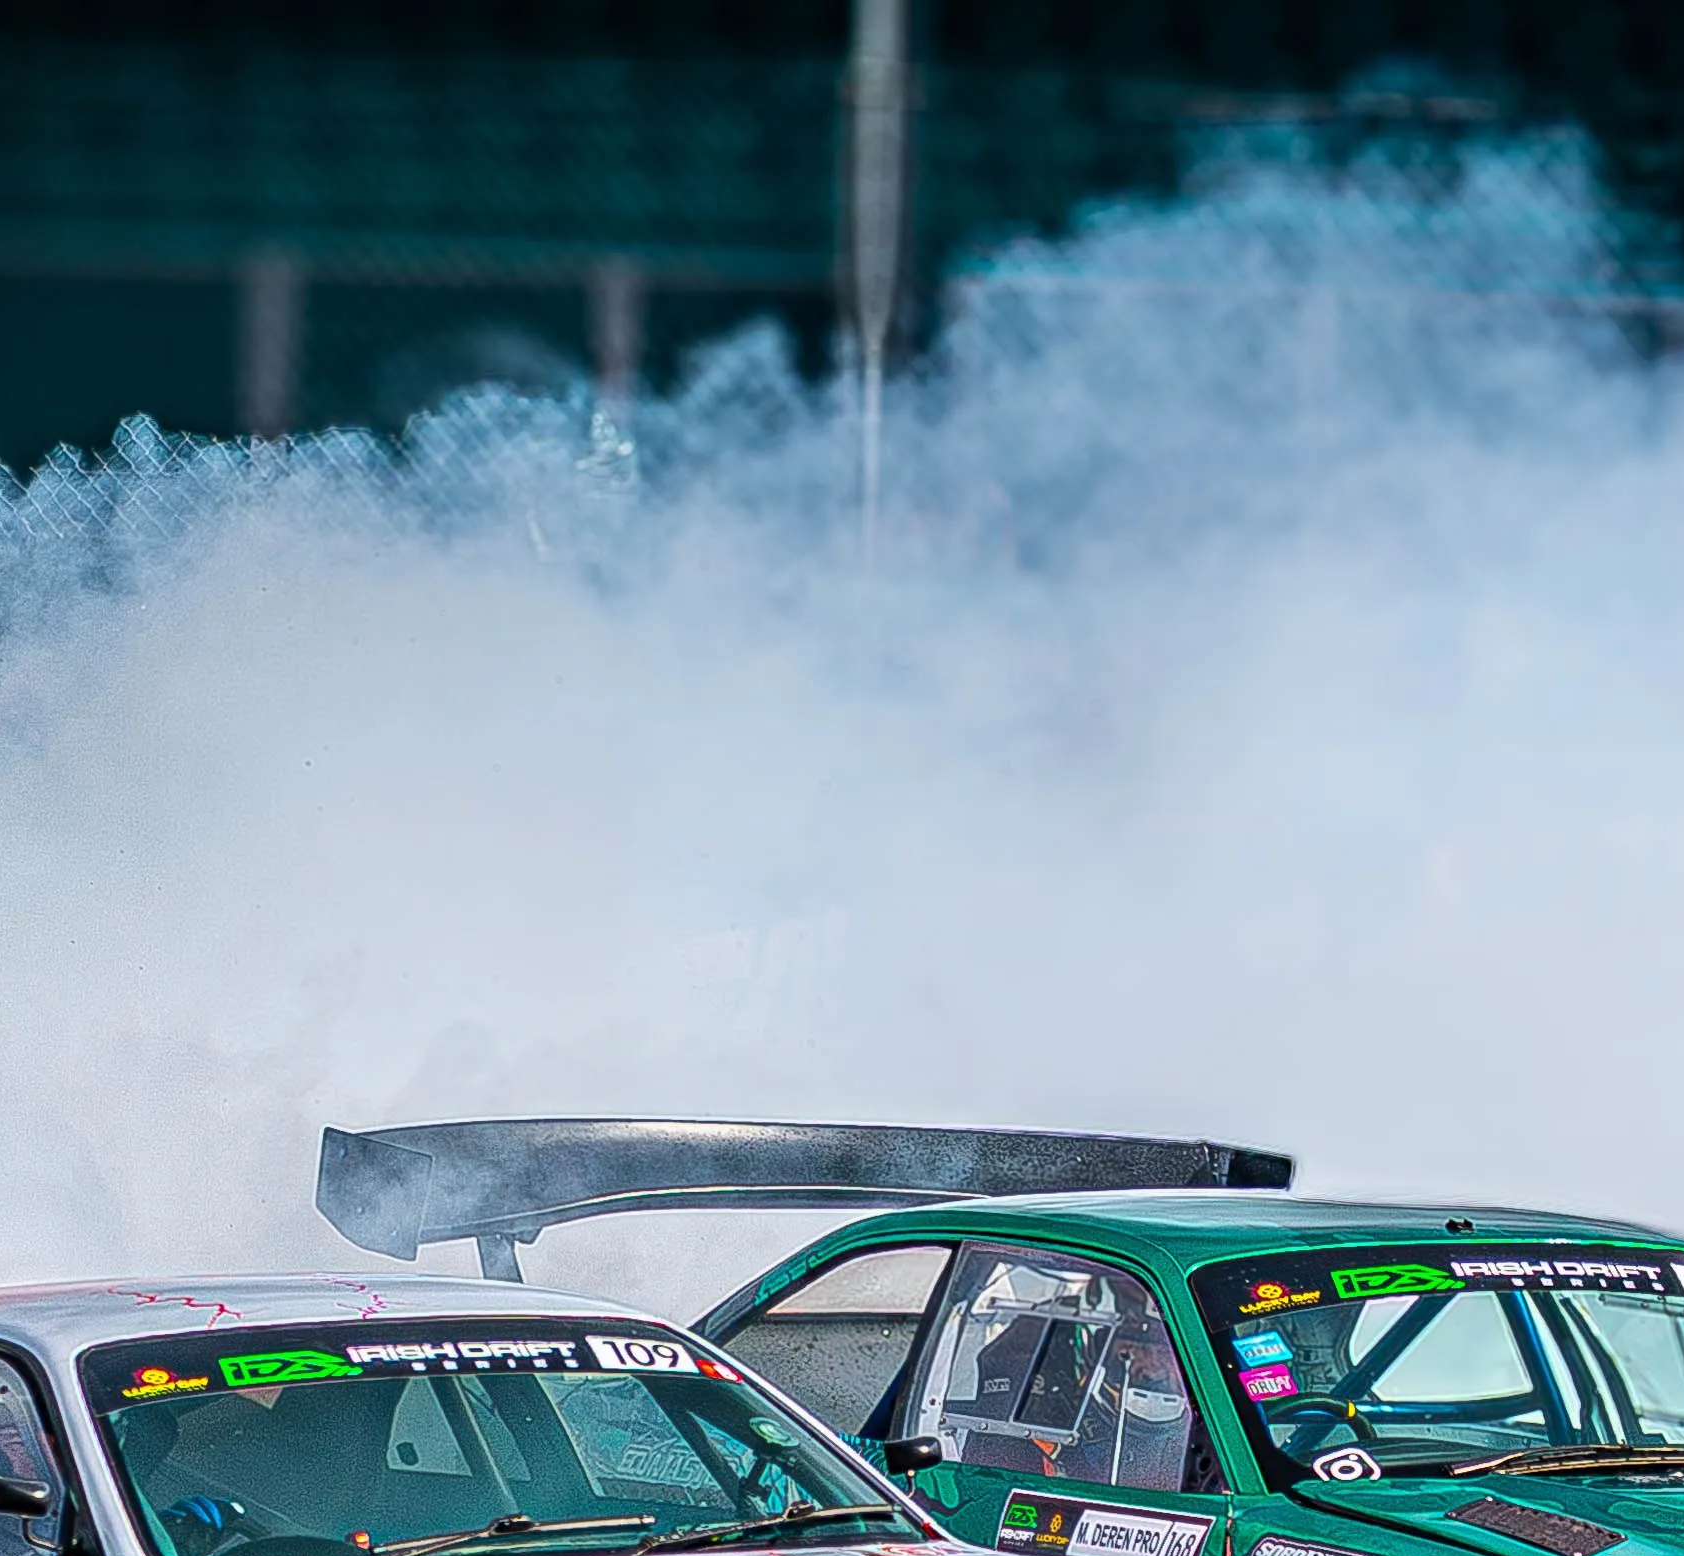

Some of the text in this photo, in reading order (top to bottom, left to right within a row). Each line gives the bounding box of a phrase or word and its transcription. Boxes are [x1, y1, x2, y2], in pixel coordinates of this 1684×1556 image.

[1451, 1261, 1662, 1280] IRISH DRIFT
[601, 1340, 682, 1368] 109
[1076, 1522, 1089, 1545] M.
[1091, 1525, 1132, 1551] DEREN
[1134, 1530, 1160, 1554] PRO
